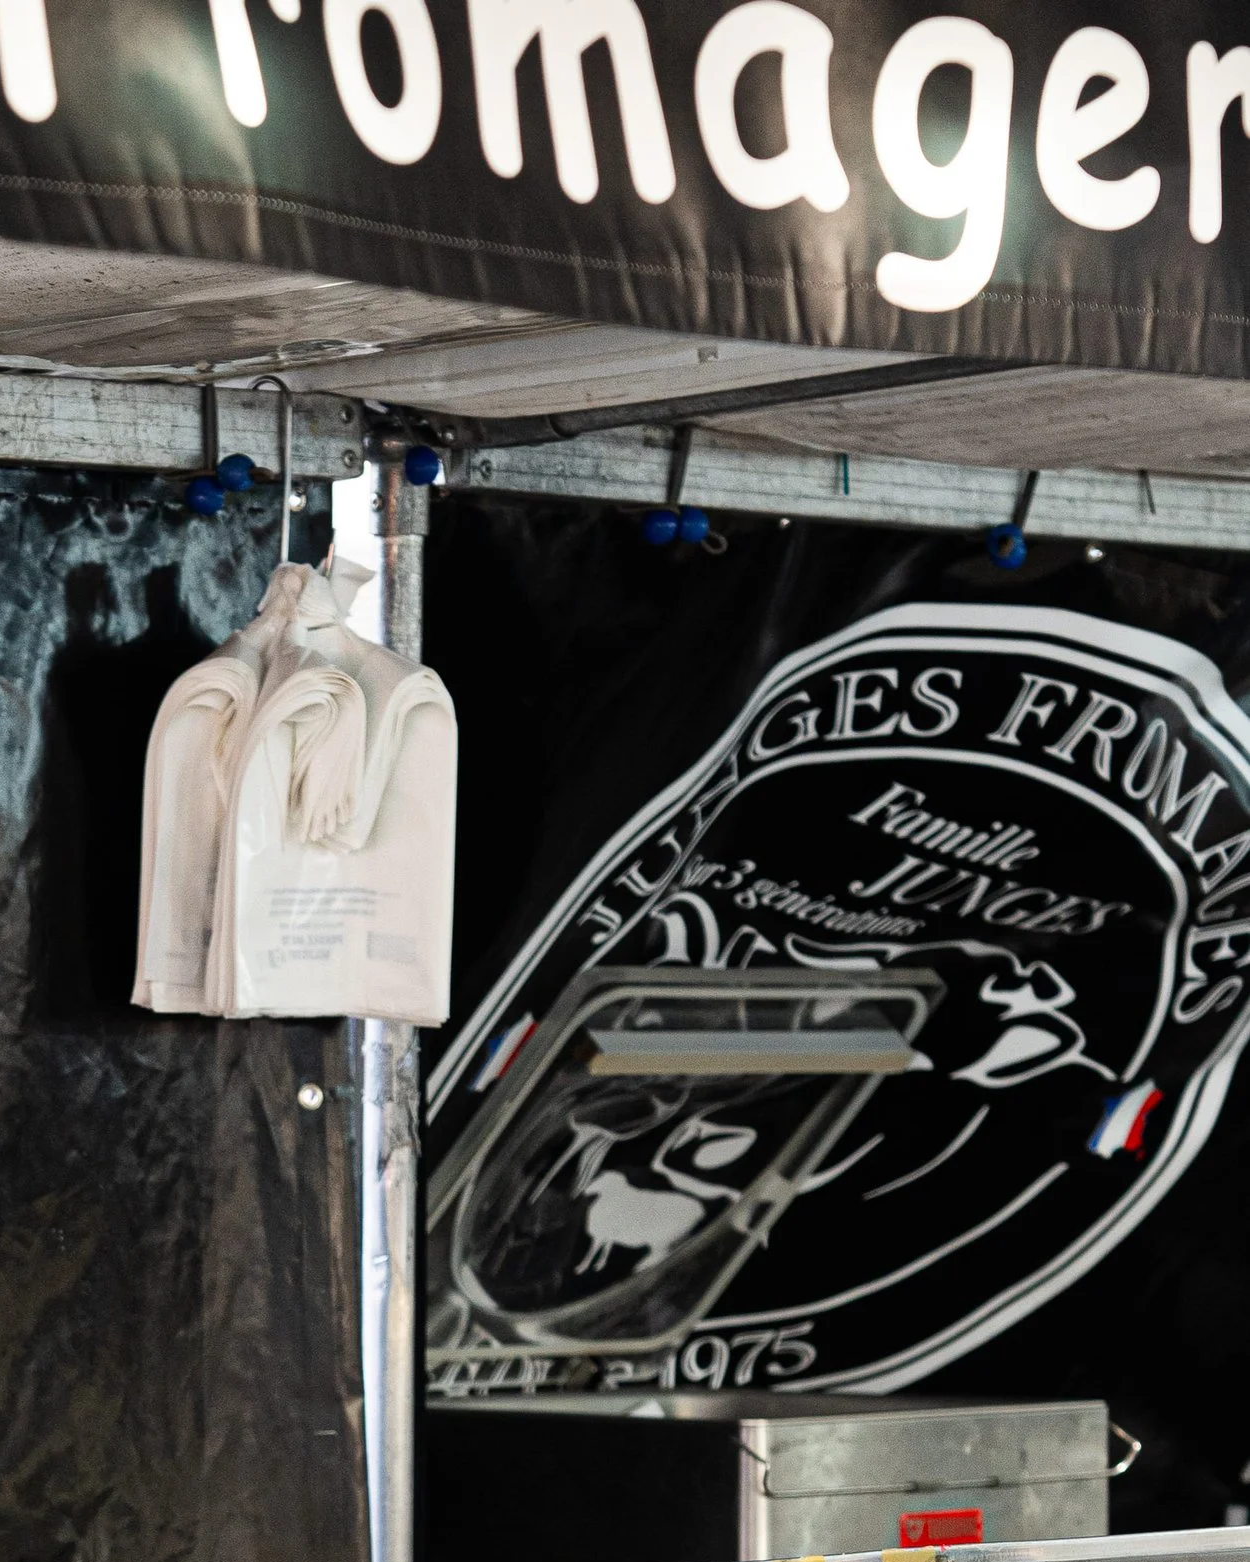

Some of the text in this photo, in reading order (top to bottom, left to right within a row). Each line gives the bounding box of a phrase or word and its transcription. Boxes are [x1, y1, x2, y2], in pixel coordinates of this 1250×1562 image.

[848, 781, 1041, 871] Famille
[713, 858, 757, 890] 3
[849, 853, 1133, 935] JUNGES
